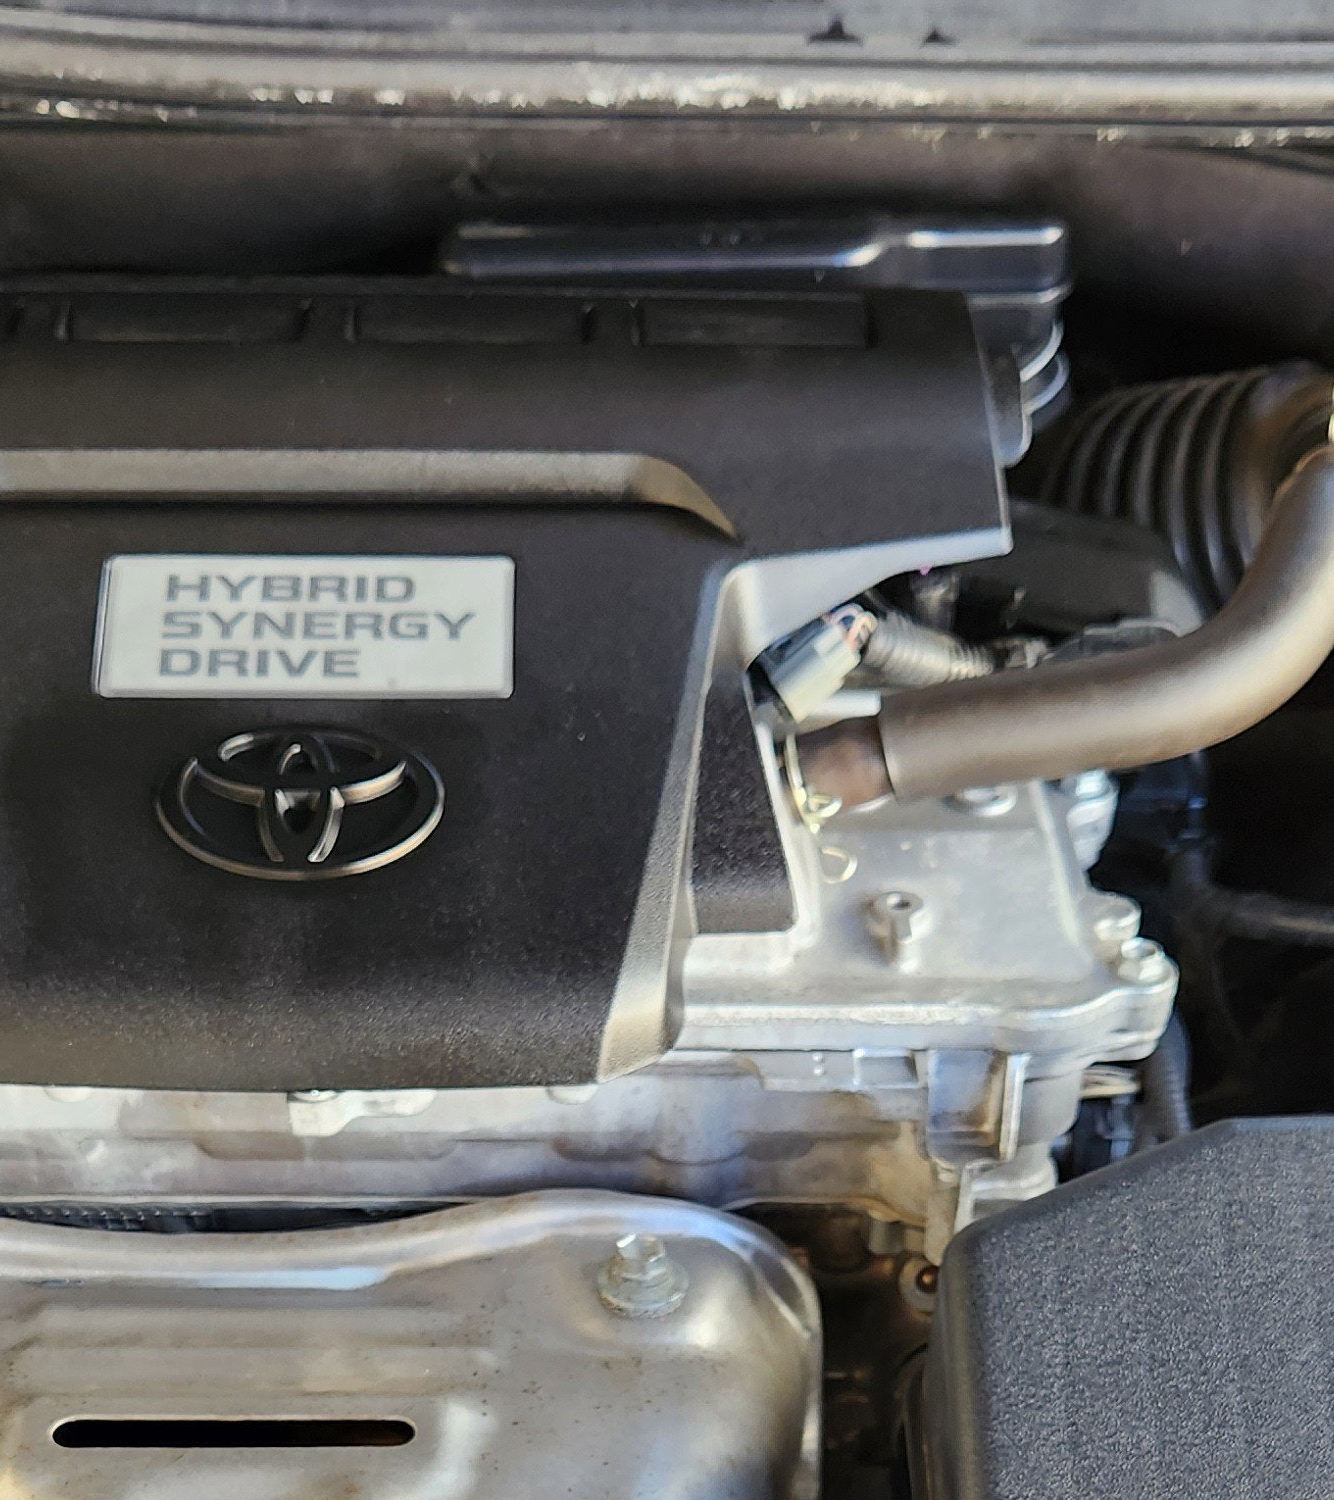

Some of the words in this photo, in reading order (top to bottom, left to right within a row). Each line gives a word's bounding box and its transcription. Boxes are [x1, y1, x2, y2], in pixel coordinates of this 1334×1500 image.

[165, 574, 417, 603] HYBRID
[161, 611, 476, 641] SYNERGY
[158, 648, 360, 677] DRIVE
